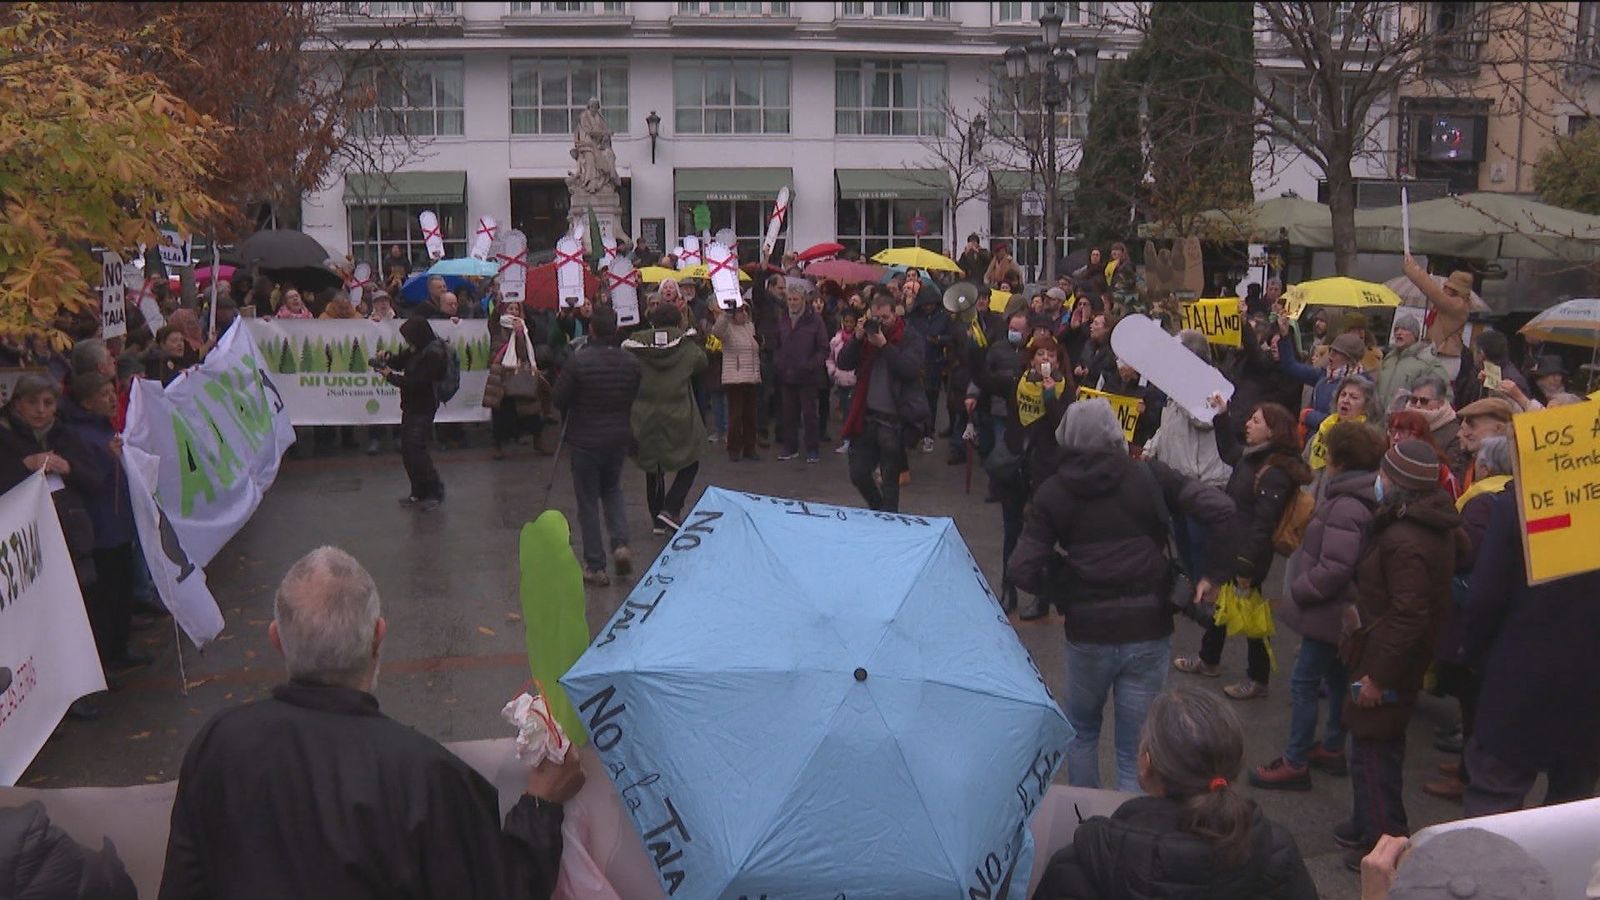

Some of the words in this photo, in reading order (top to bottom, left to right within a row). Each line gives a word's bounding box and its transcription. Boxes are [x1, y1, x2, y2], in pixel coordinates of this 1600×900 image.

[105, 261, 123, 287] NO
[1183, 304, 1224, 336] TALA
[1223, 314, 1240, 331] NO
[300, 376, 321, 387] NI
[324, 376, 368, 387] UNO
[1117, 404, 1137, 431] NO
[1531, 425, 1574, 451] LOS
[1531, 490, 1555, 510] DE
[671, 510, 724, 551] NO
[578, 684, 627, 753] NO
[968, 851, 1002, 900] NO
